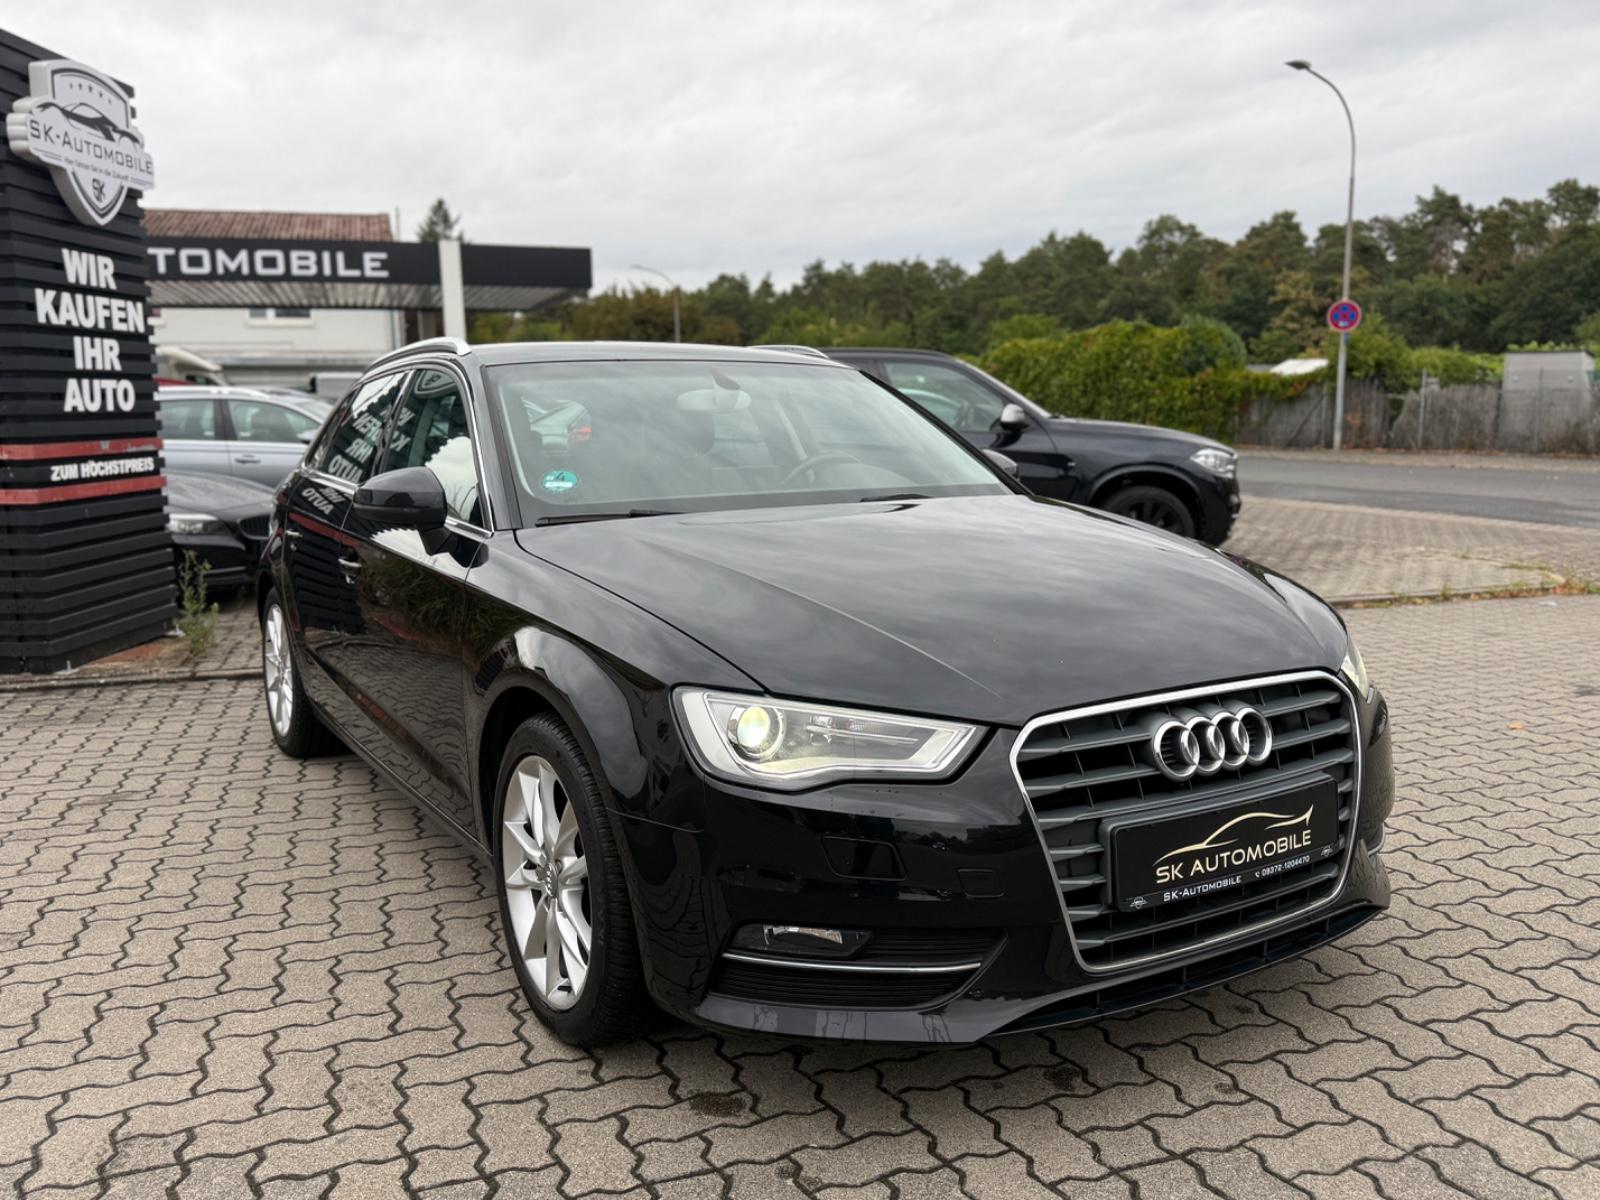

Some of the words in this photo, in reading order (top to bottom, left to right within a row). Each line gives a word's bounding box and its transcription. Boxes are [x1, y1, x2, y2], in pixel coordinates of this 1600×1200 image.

[30, 119, 153, 175] SK-AUTOMOBILE
[61, 248, 117, 290] WIR
[34, 288, 145, 333] KAUFEN
[73, 335, 122, 371] IHR
[63, 378, 136, 412] AUTO
[50, 465, 79, 482] ZUM
[80, 457, 155, 479] HÖCHSTPREIS
[1155, 862, 1184, 884] SK
[1190, 829, 1312, 877] AUTOMOBILE
[1163, 875, 1242, 902] SK-AUTOMOBILE
